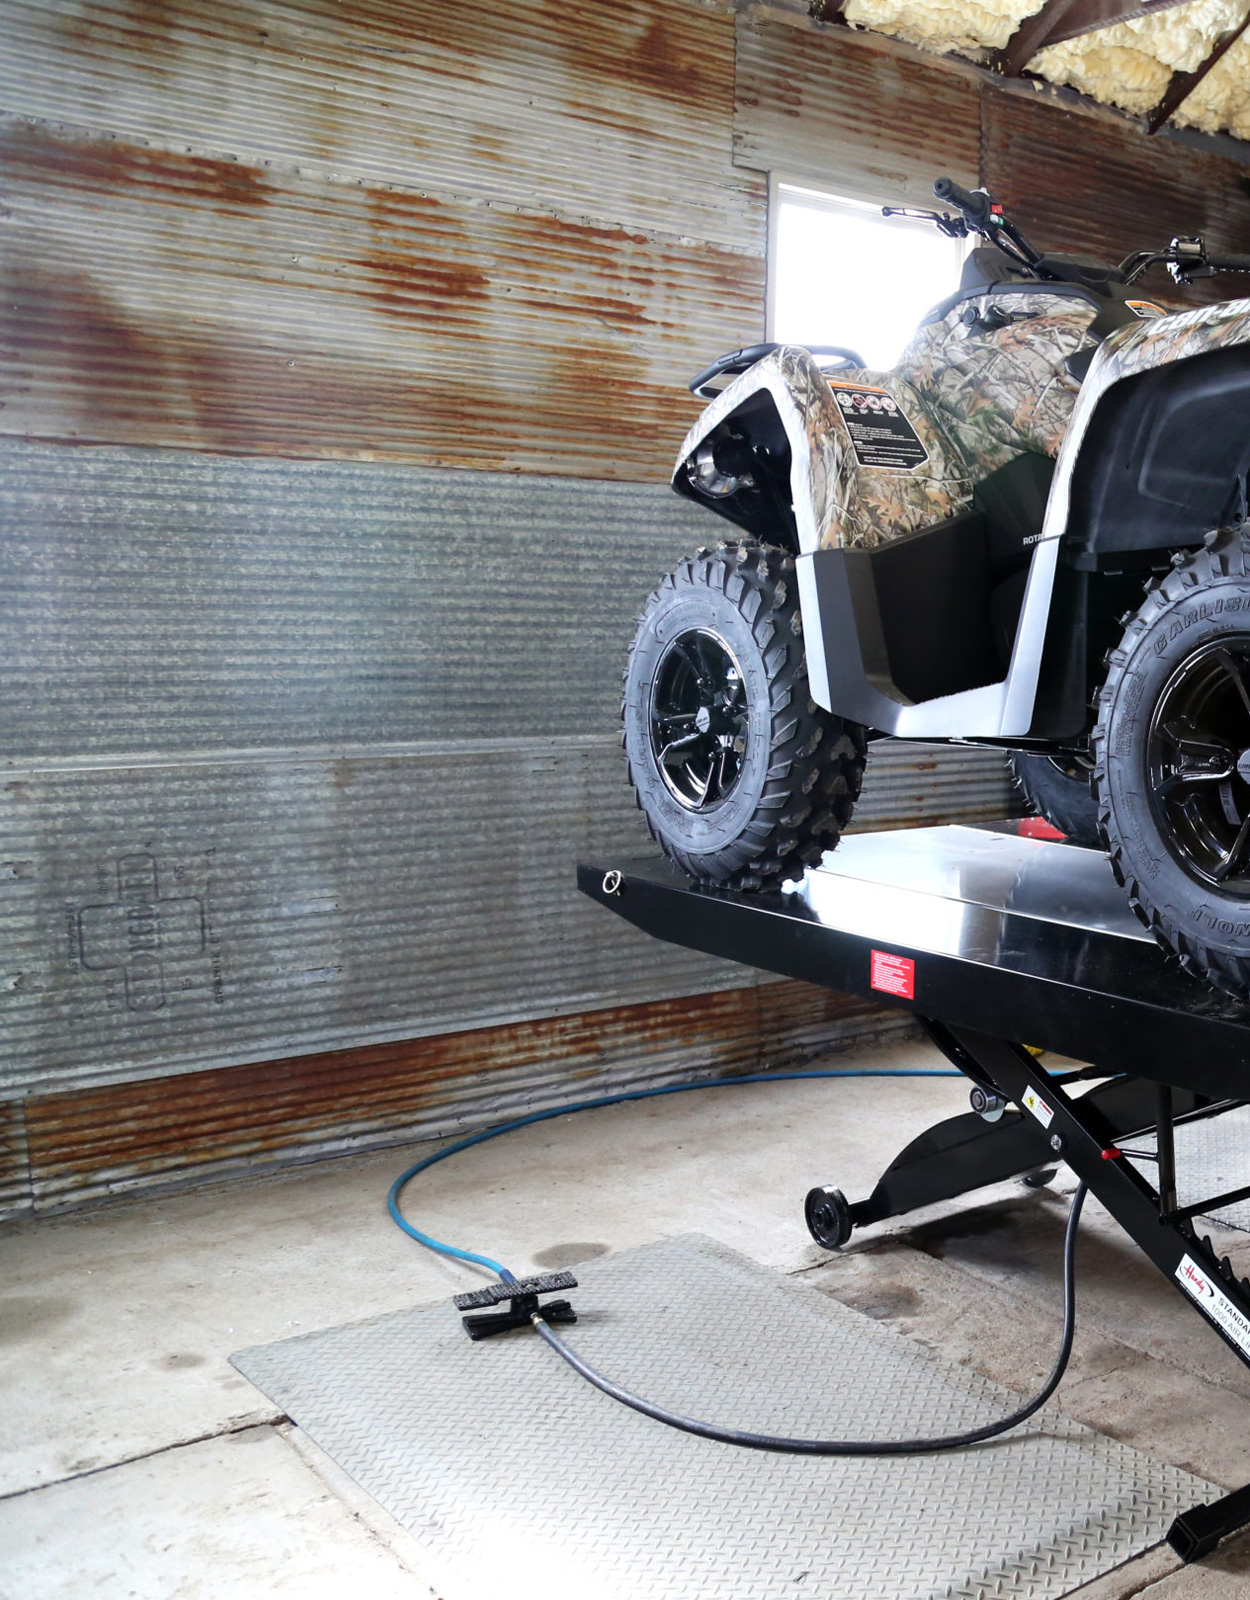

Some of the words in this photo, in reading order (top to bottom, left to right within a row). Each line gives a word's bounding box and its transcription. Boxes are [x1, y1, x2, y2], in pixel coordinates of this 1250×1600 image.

[1023, 534, 1044, 546] ROTA
[1183, 1264, 1205, 1294] Handy
[1227, 1322, 1242, 1340] AIR
